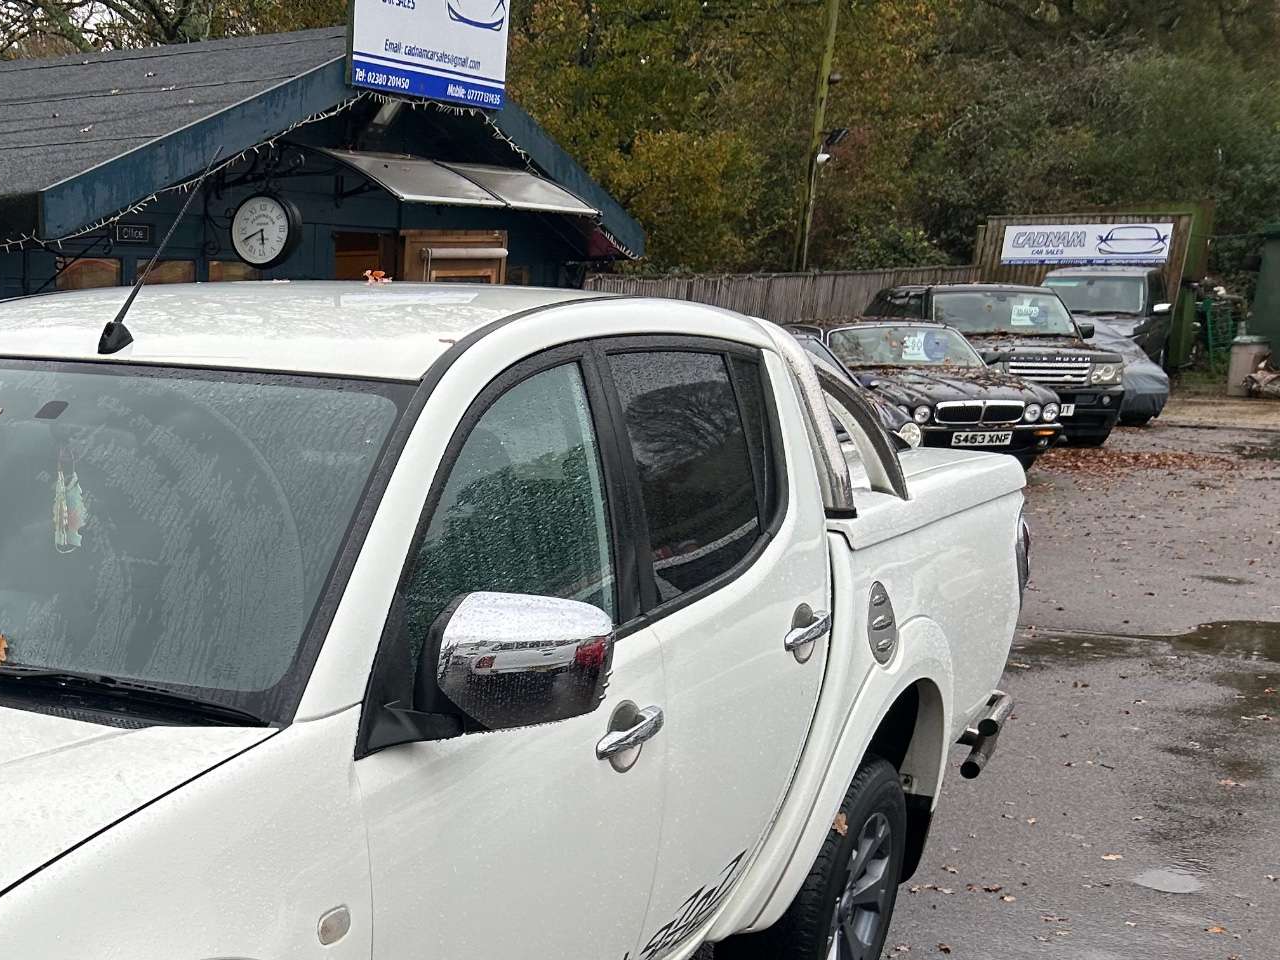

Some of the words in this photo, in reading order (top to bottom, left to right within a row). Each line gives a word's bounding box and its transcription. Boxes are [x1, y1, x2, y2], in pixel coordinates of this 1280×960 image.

[355, 68, 366, 82] Tel:
[367, 72, 387, 86] 02380
[387, 75, 410, 90] 201450
[447, 83, 466, 99] Mobile:
[1012, 231, 1087, 248] CADNAM
[987, 433, 1011, 444] XNF
